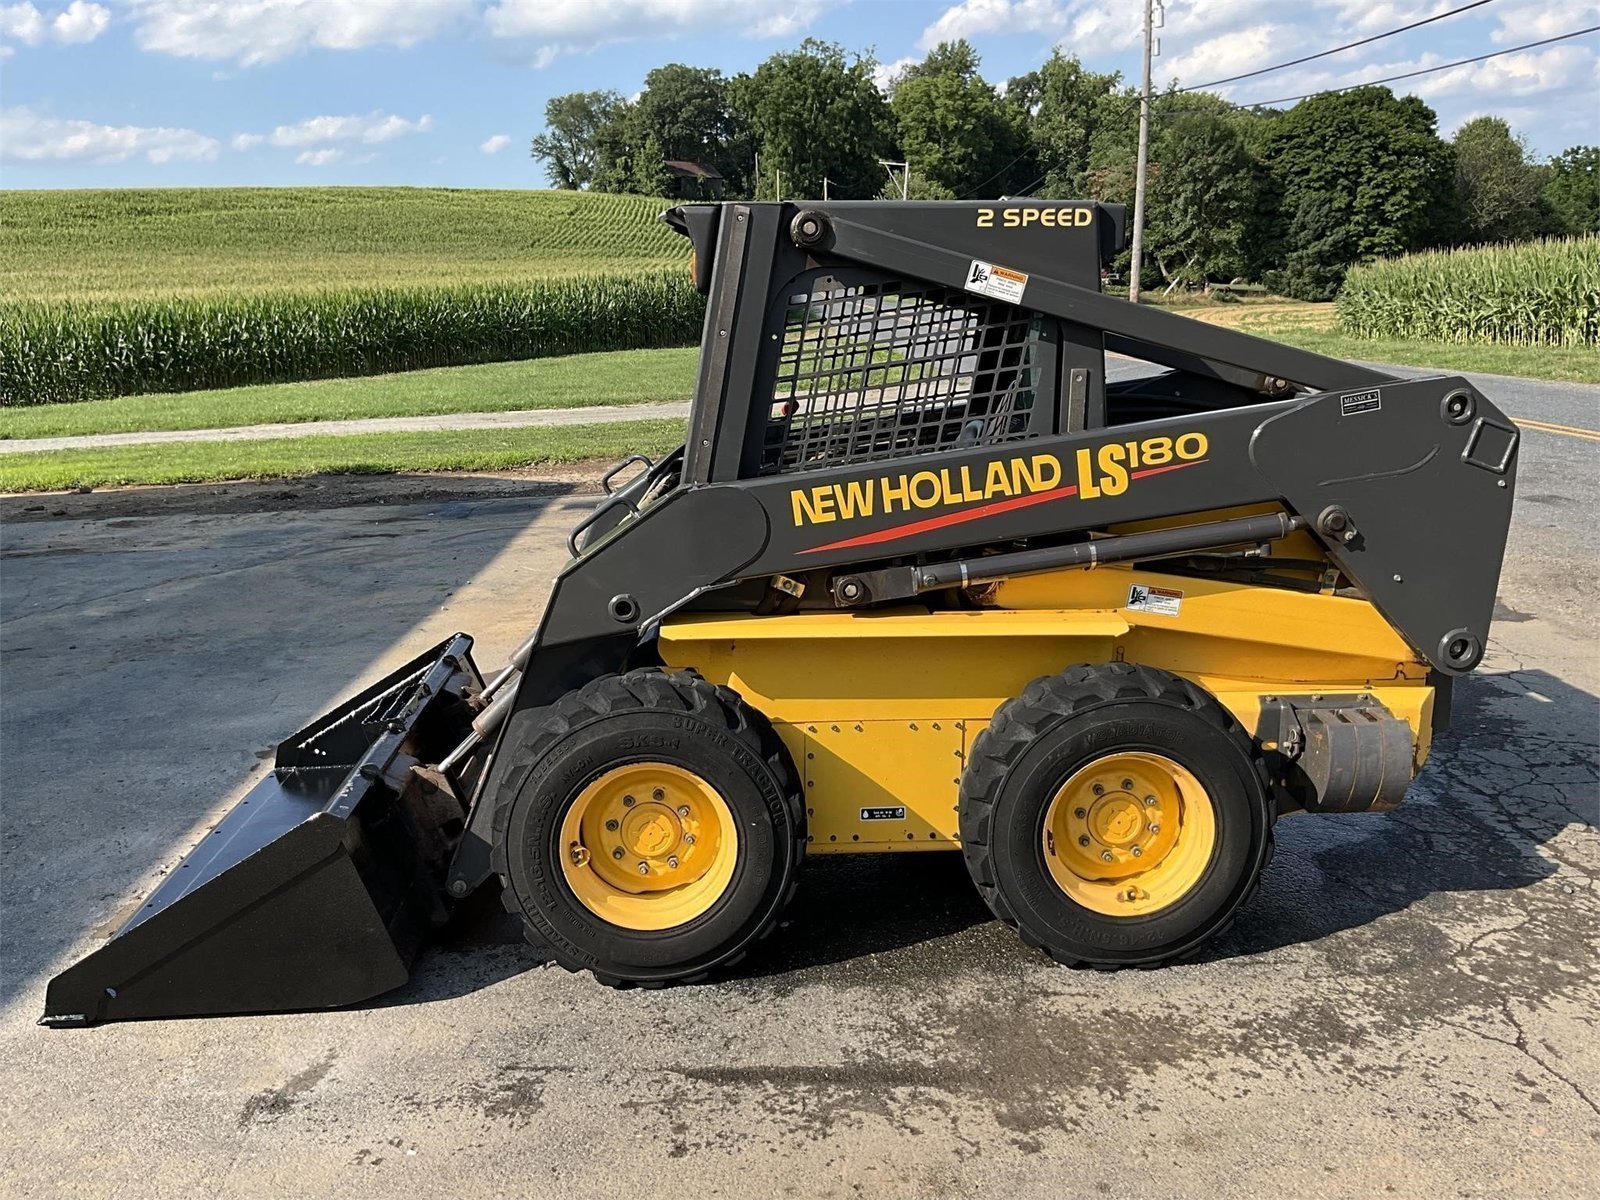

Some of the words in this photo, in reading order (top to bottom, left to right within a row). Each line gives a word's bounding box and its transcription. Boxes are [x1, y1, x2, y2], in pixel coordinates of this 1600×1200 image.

[976, 208, 994, 227] 2
[1003, 208, 1092, 227] SPEED
[790, 480, 874, 527] NEW
[880, 454, 1062, 514] HOLLAND
[672, 716, 729, 747] SUPER
[730, 743, 787, 827] TRACTION
[522, 894, 580, 957] STABILITY
